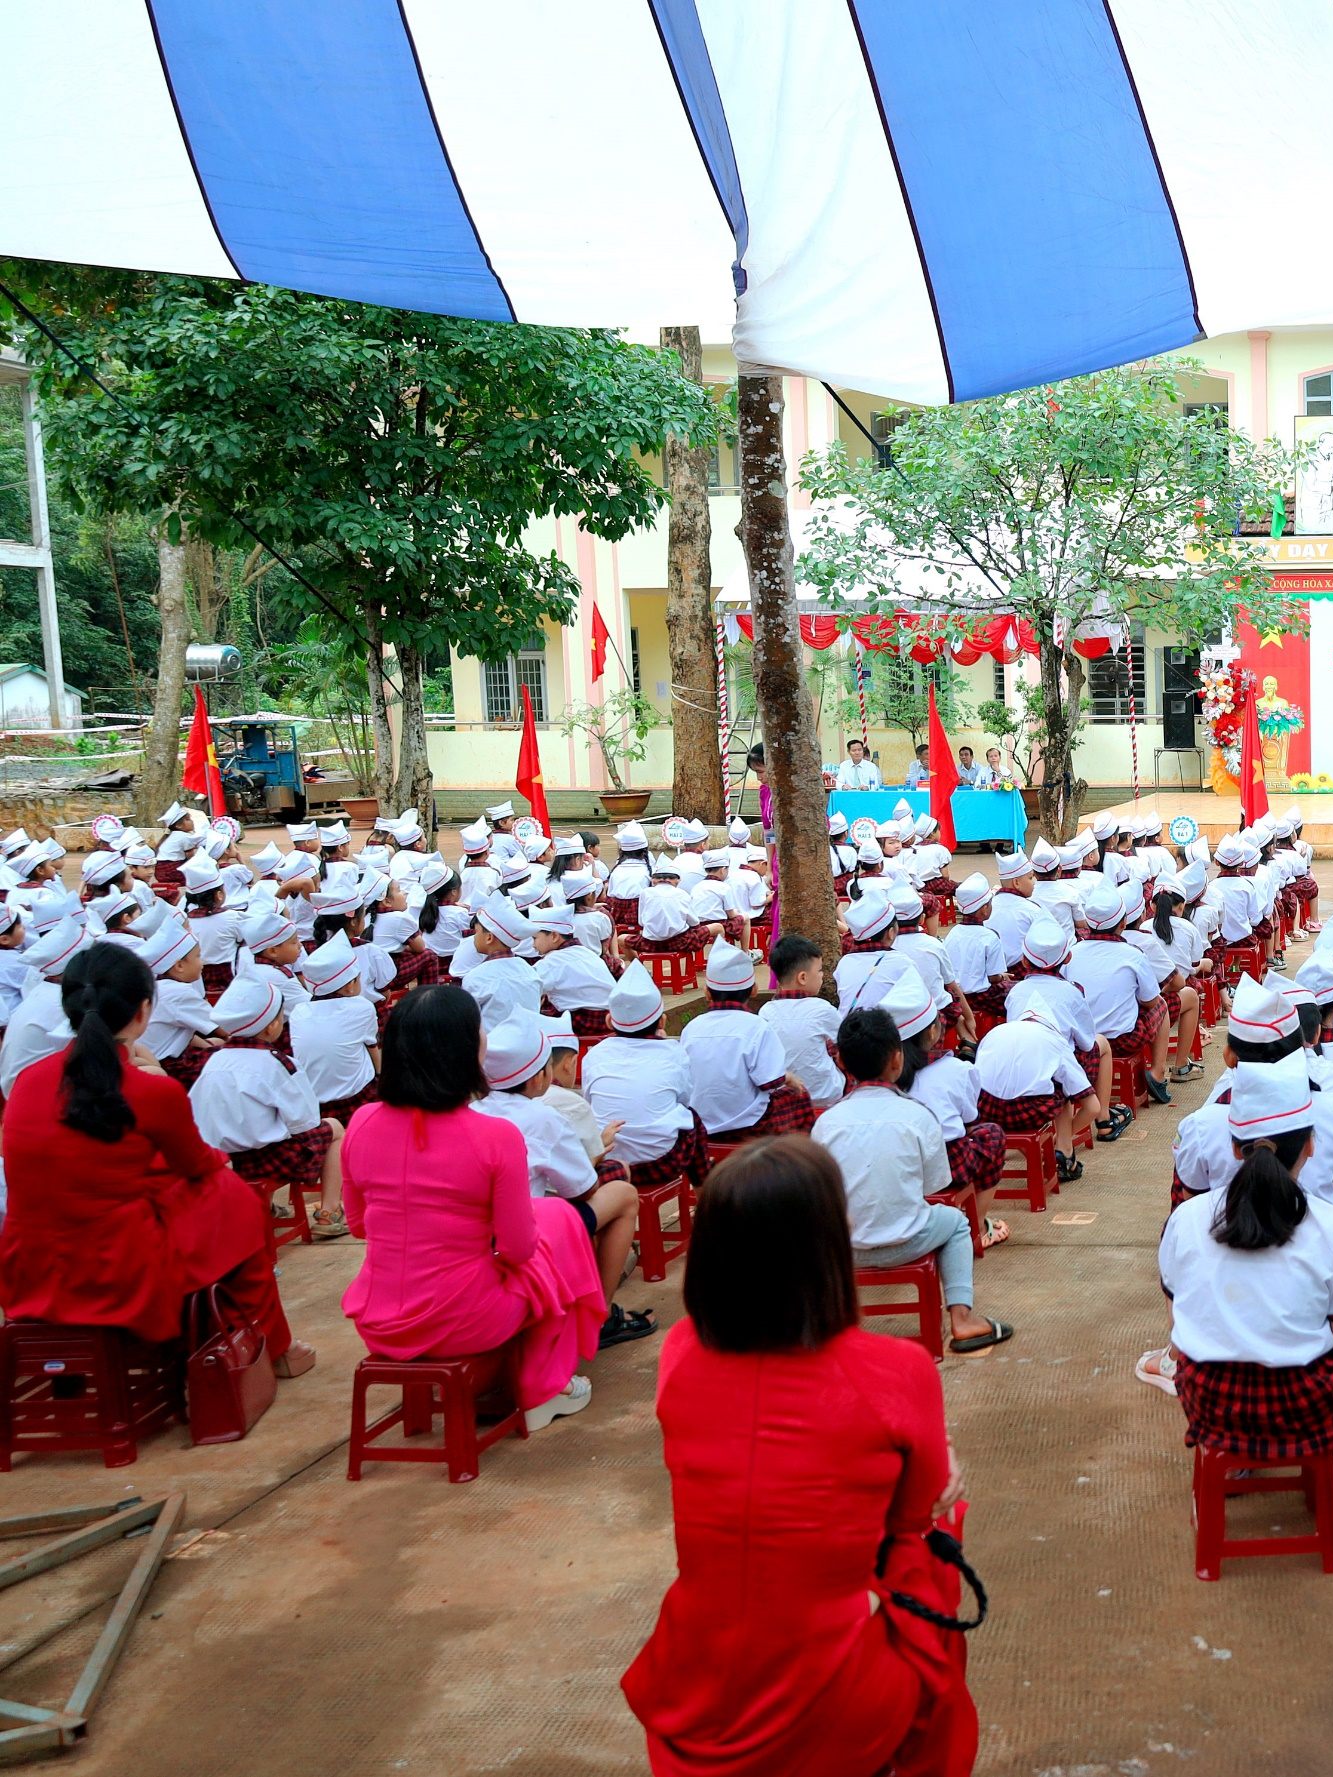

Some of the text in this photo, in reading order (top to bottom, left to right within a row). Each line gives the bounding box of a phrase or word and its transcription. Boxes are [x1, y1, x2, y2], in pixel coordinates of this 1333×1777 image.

[1288, 543, 1328, 560] DẠY
[1273, 578, 1300, 590] CỘNG
[1302, 578, 1323, 589] HÒA
